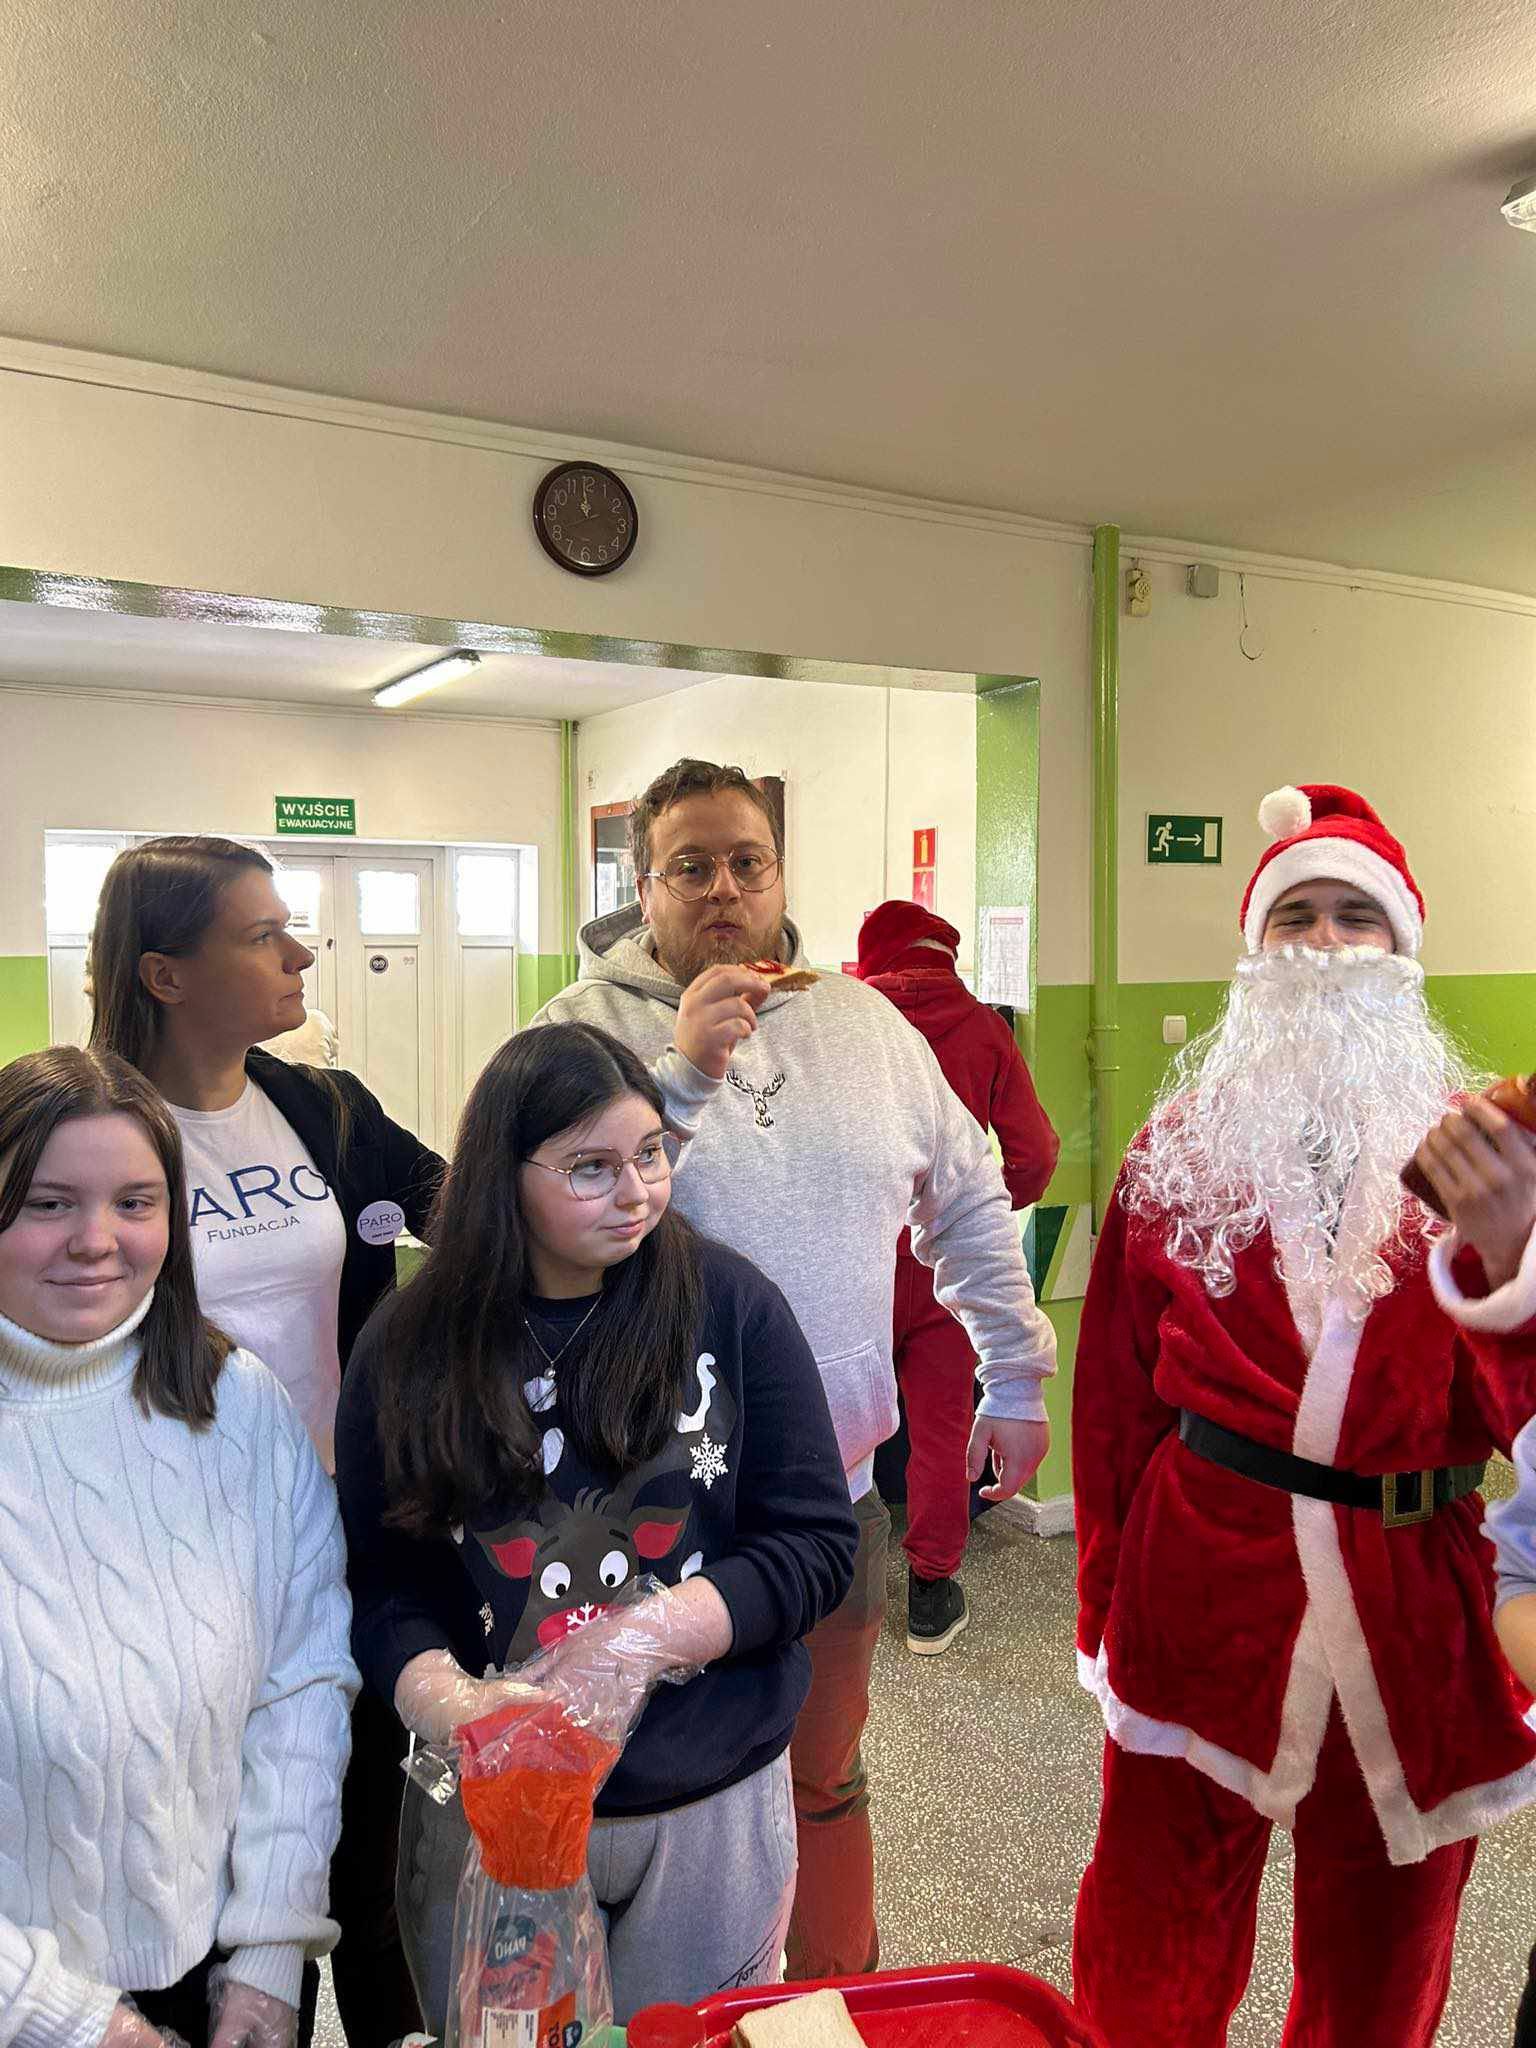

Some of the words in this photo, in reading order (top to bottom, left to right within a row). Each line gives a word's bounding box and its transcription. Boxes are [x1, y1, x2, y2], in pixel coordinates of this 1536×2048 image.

[546, 503, 557, 520] 9
[611, 498, 623, 514] 2
[551, 524, 562, 541] 8
[616, 518, 627, 534] 3
[565, 538, 574, 556] 7
[610, 535, 620, 552] 4
[580, 545, 592, 562] 6
[597, 544, 608, 561] 5
[282, 801, 350, 817] WYJŚCIE
[279, 818, 354, 830] EWAKUACYJNE
[190, 1165, 330, 1227] ARO
[207, 1214, 301, 1243] FUNDACJA
[360, 1212, 402, 1232] PARO
